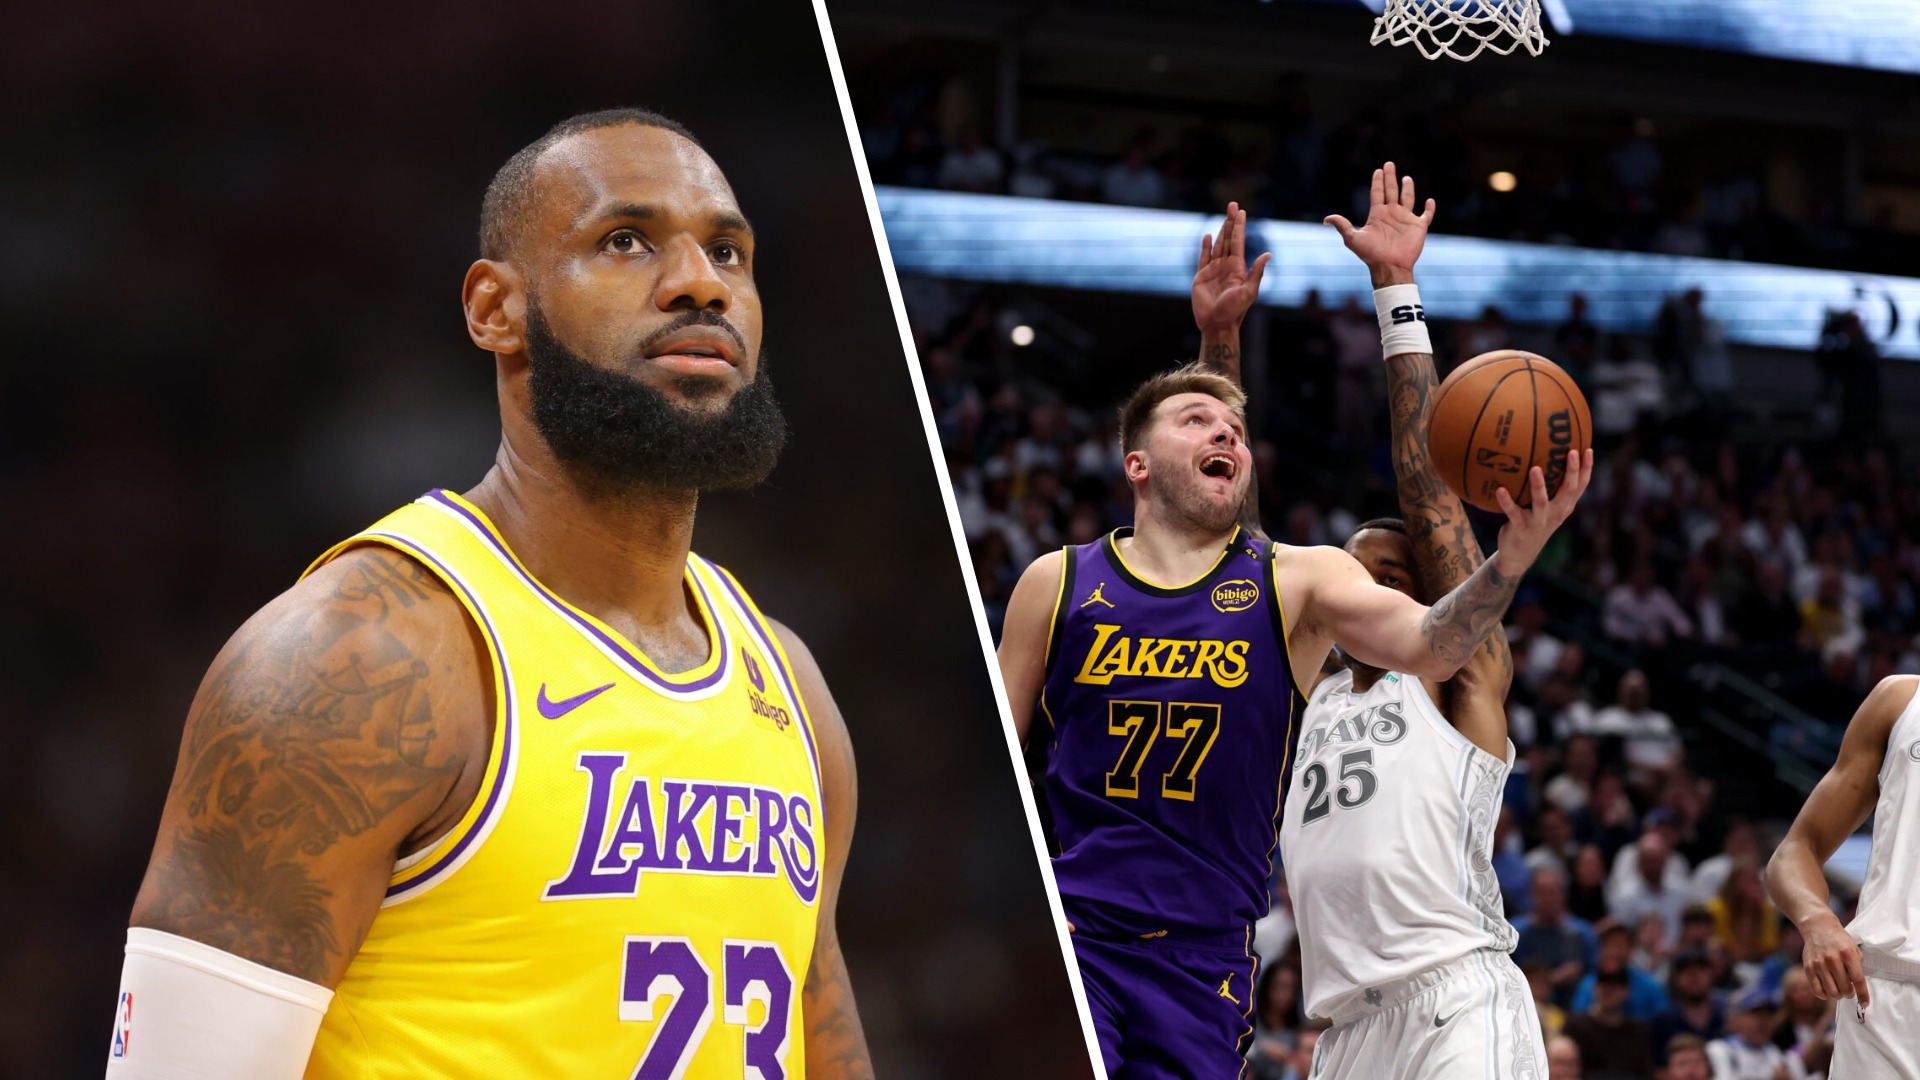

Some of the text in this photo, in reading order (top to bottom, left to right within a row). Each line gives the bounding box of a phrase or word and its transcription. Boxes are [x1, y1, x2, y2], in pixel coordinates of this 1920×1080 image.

[1216, 588, 1257, 602] bibigo
[1074, 624, 1250, 688] LAKERS
[747, 688, 790, 732] bibigo
[1106, 700, 1222, 802] 77
[1301, 747, 1378, 828] 25
[541, 751, 822, 906] LAKERS
[618, 934, 796, 1080] 23
